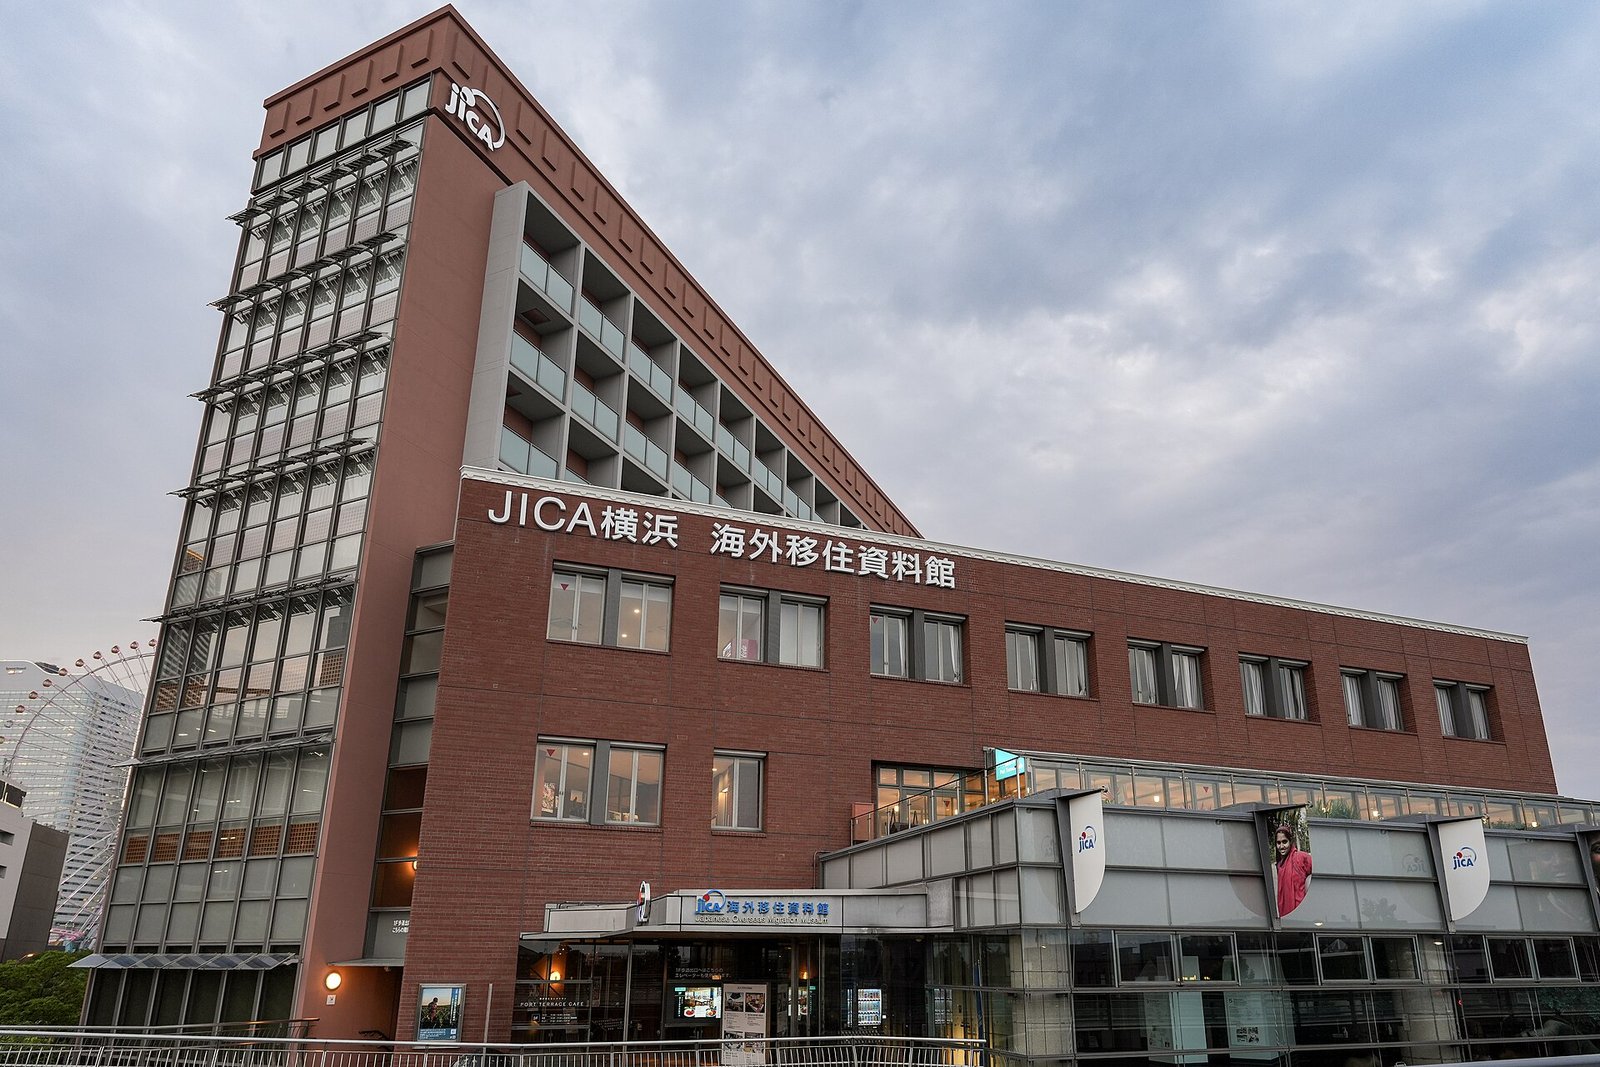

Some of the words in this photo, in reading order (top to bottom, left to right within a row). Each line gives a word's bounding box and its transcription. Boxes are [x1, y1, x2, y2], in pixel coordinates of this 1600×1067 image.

[488, 491, 678, 548] JICA横浜
[710, 522, 956, 588] 海外移住資料館
[726, 901, 829, 917] 海外移住資料館
[695, 915, 730, 924] Japanese
[731, 915, 766, 924] Overseas
[800, 916, 829, 925] Museum
